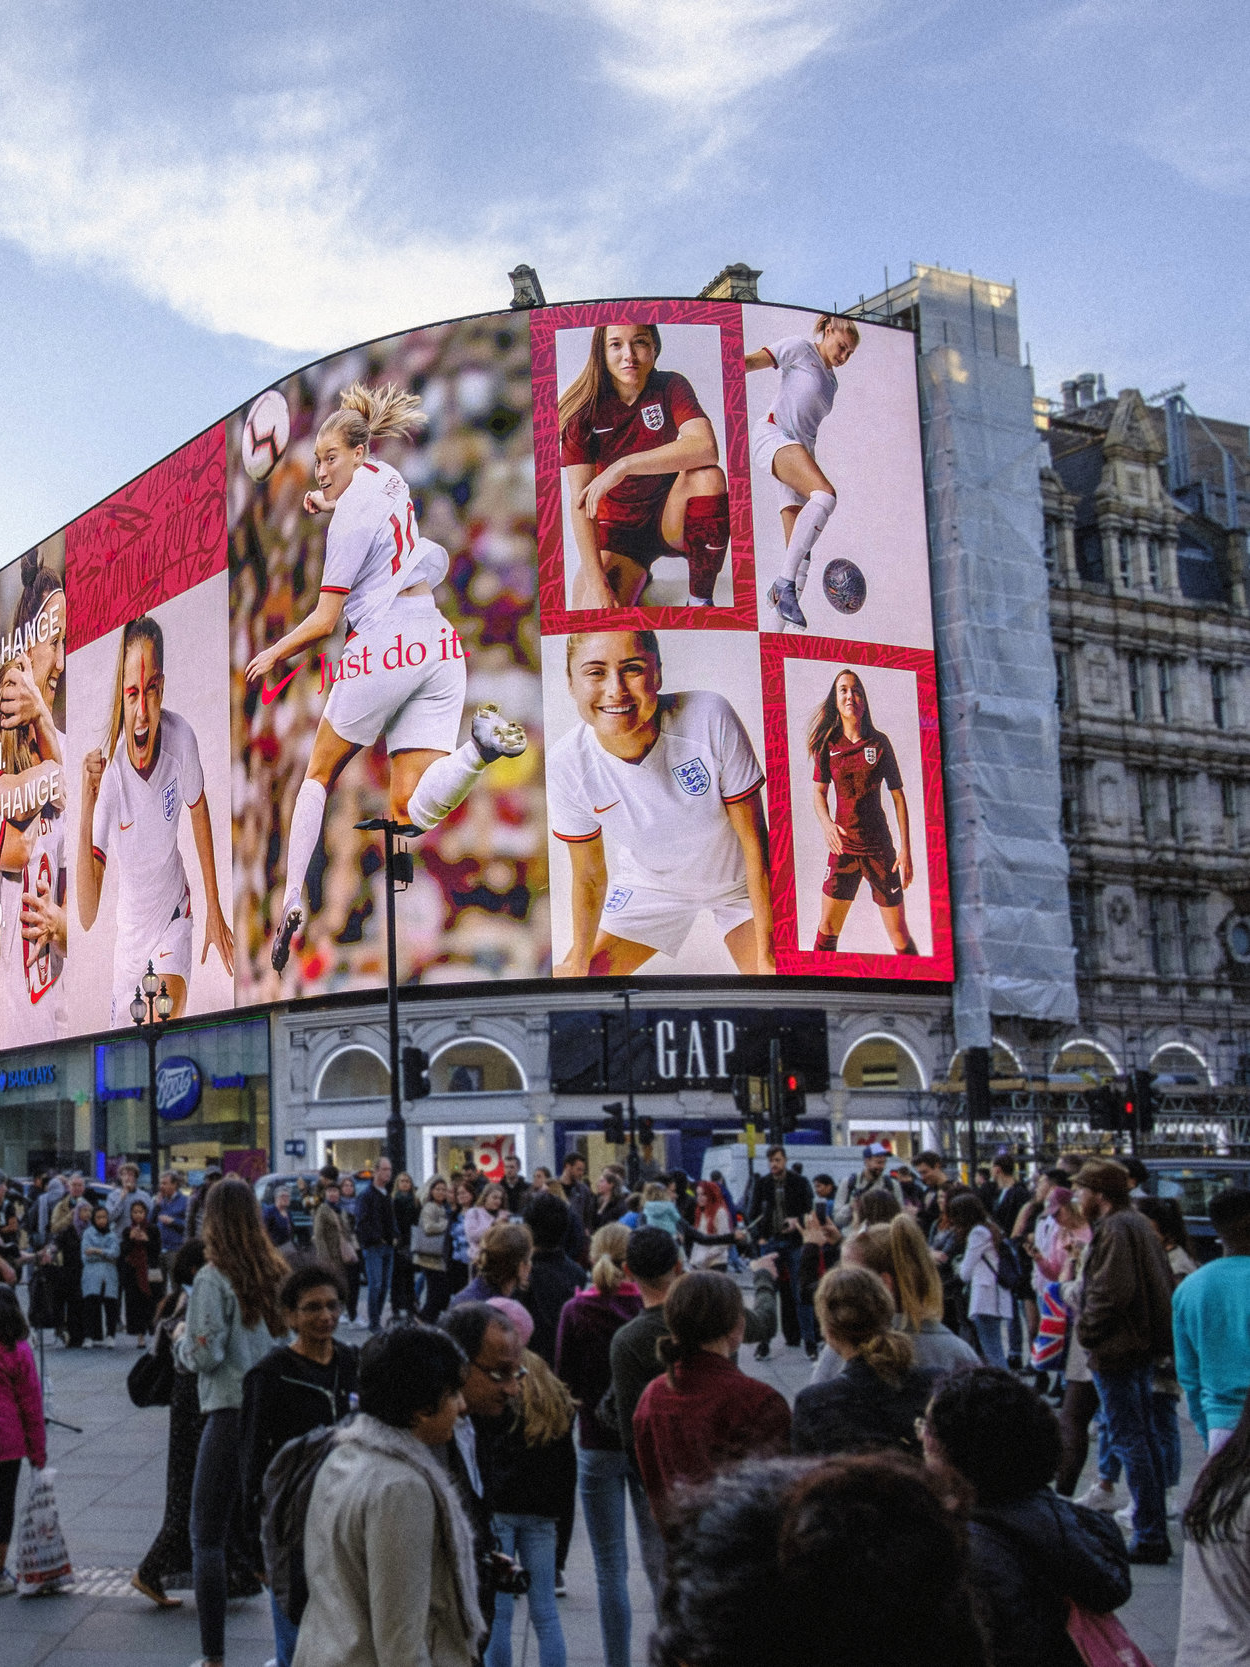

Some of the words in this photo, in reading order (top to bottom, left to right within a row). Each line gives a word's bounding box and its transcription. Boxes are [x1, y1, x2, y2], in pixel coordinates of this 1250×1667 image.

[317, 645, 372, 695] Just
[383, 634, 427, 671] do
[438, 627, 471, 662] it.
[656, 1019, 735, 1079] GAP
[7, 1064, 55, 1088] BARCLAYS
[155, 1066, 192, 1109] Boots
